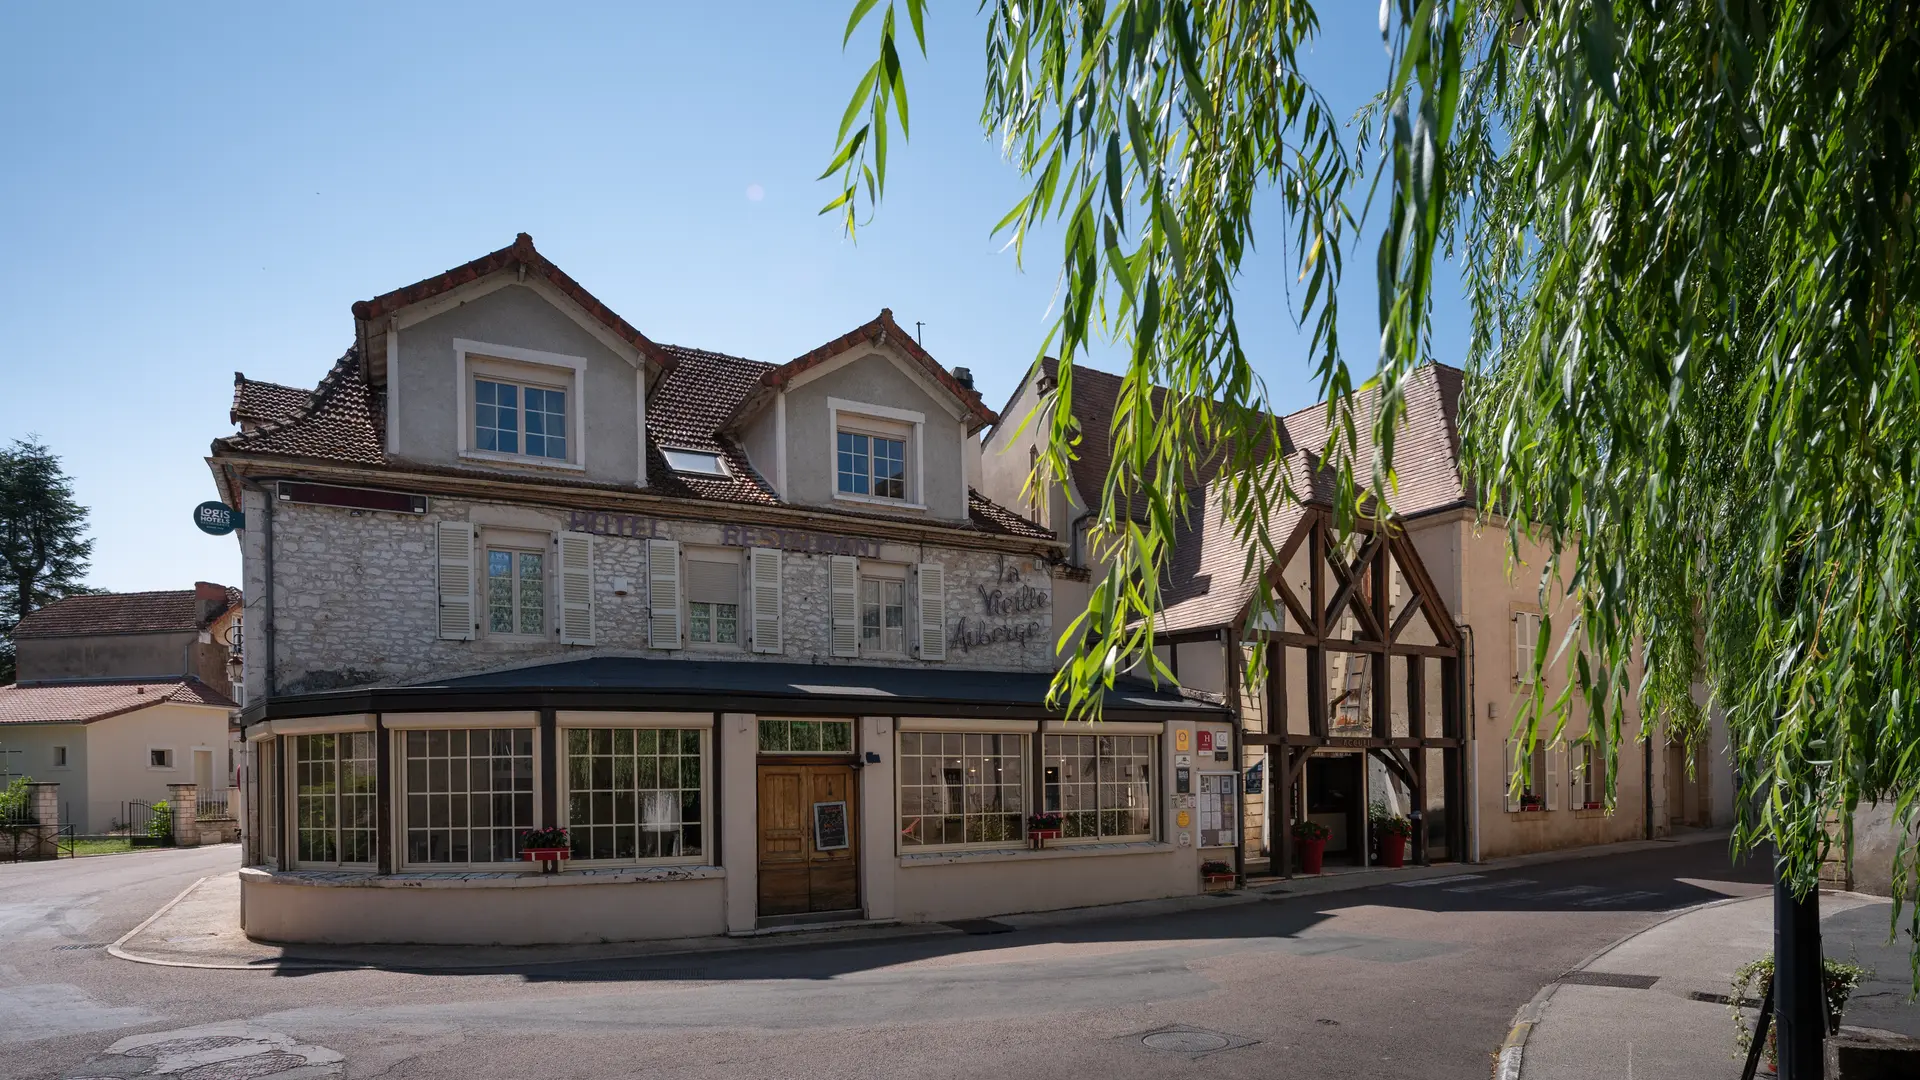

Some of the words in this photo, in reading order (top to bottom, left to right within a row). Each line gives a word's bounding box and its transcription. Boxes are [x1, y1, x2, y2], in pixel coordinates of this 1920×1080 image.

[570, 511, 667, 540] HOTEL
[722, 525, 881, 559] RESTAURANT
[950, 616, 1040, 653] Auberge
